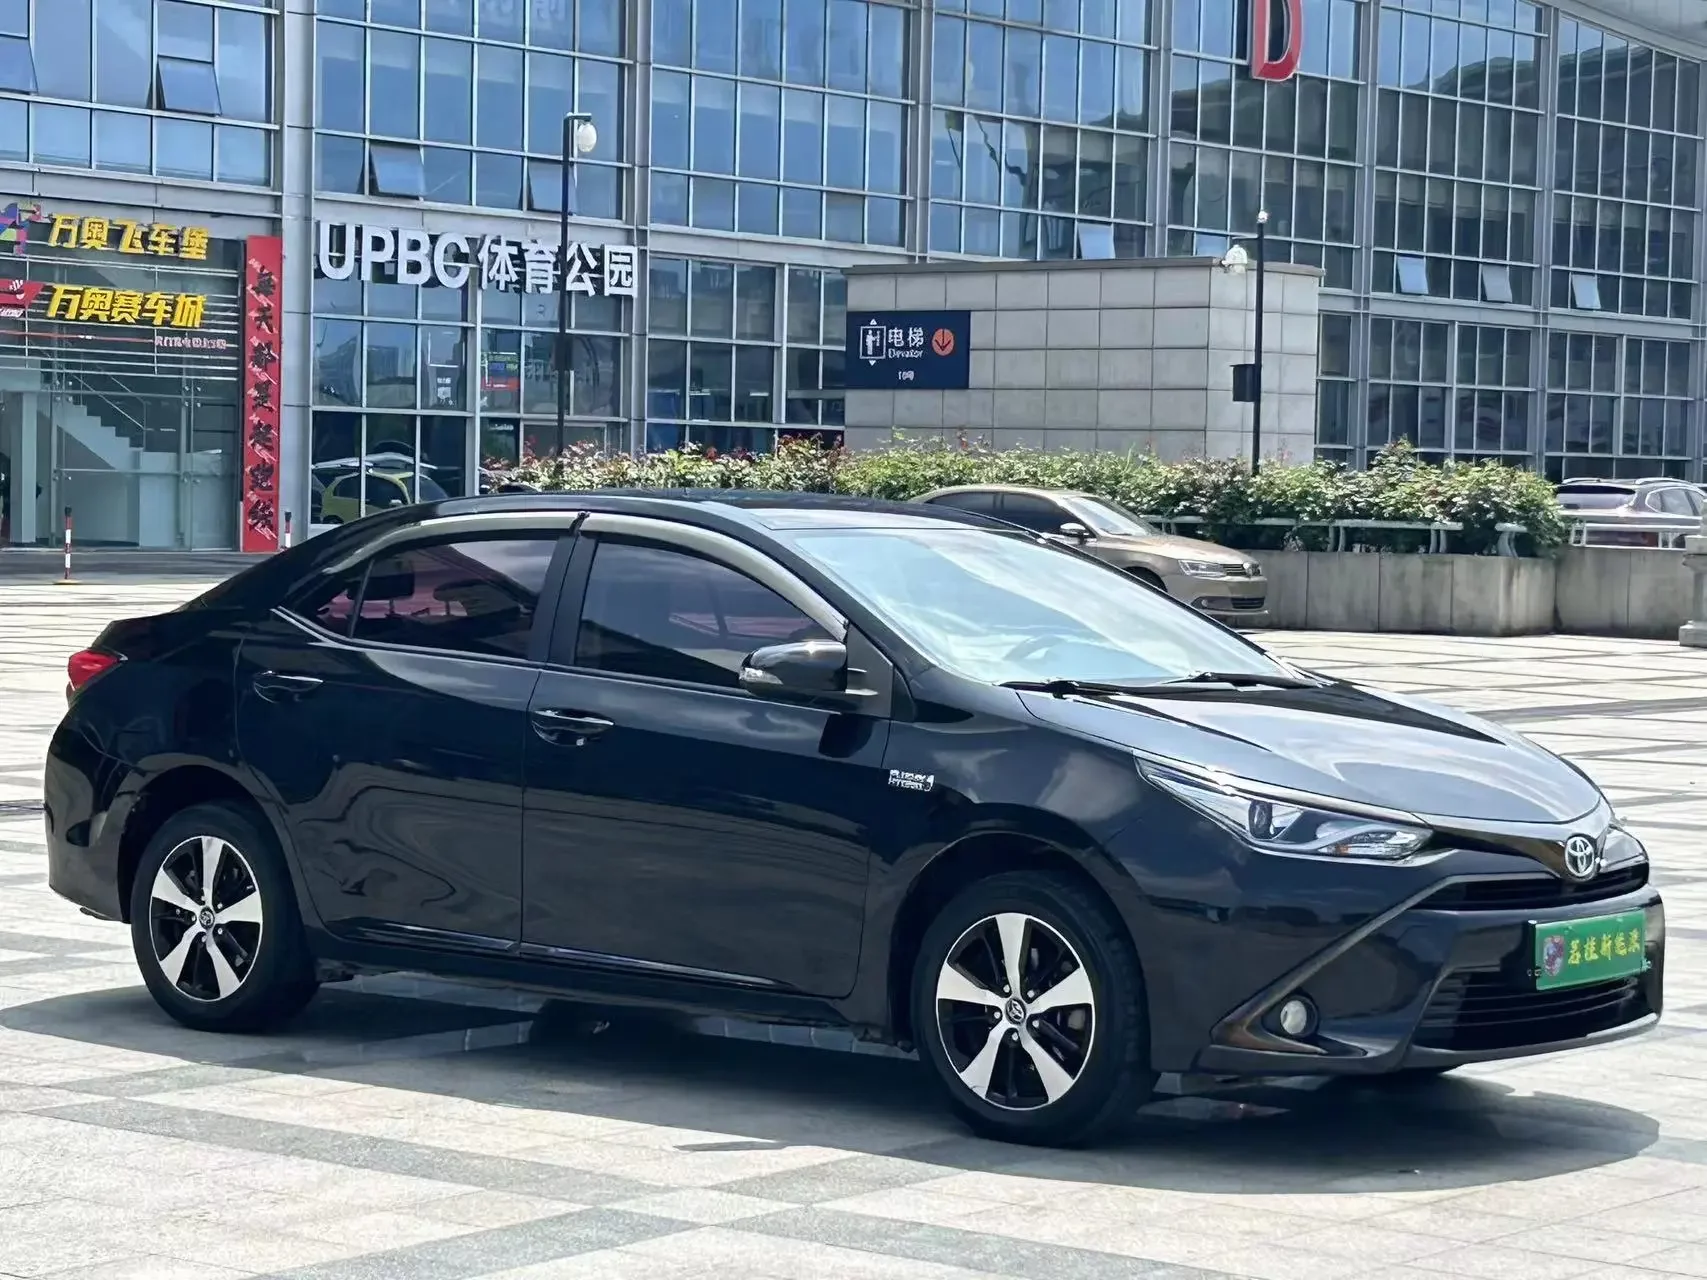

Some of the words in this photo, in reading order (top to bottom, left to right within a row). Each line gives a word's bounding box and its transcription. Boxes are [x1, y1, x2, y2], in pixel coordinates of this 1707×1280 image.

[47, 213, 209, 260] 万奥飞车堡
[46, 284, 208, 328] 万奥赛车城
[888, 327, 924, 347] 电梯
